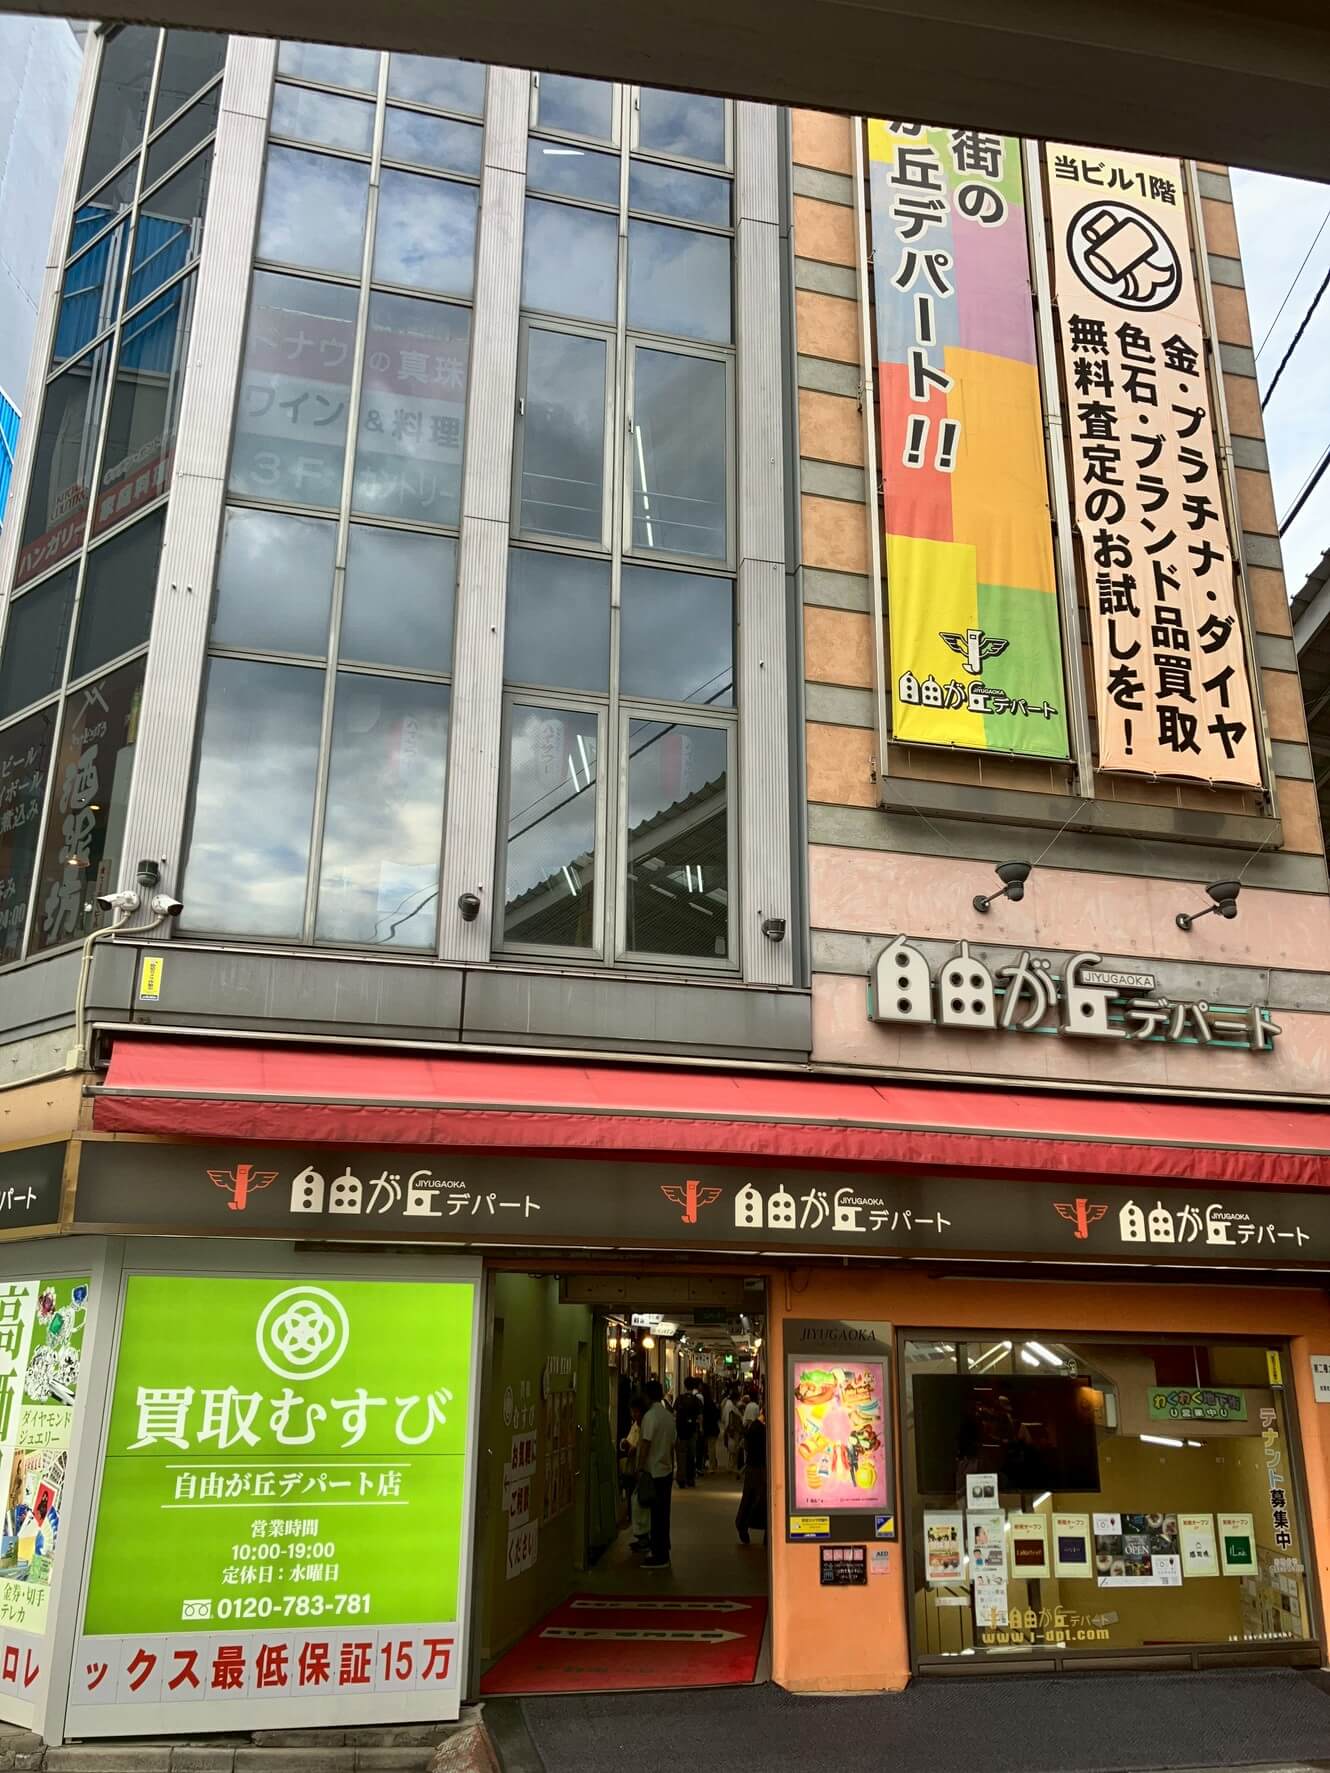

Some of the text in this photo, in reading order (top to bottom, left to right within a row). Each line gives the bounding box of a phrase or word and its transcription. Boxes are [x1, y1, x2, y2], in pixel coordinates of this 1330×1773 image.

[1053, 153, 1178, 206] 当ビル1階
[1115, 320, 1201, 755] 色石・ブランド品買取
[1161, 333, 1247, 760] 金・プラチナ・ダイヤ
[871, 933, 1283, 1052] 自由が丘デパート
[1081, 971, 1155, 990] JIYUGAOKA
[290, 1166, 541, 1217] 自由が丘デパート
[416, 1180, 466, 1190] JIYUGAOKA
[734, 1183, 952, 1234] 自由が丘デパート
[840, 1196, 885, 1208] JIYUGAOKA
[1118, 1200, 1310, 1248] 自由が丘デパート
[1211, 1212, 1250, 1222] JIYUGAOKA
[800, 1327, 877, 1342] JIYUGAOKA
[23, 1411, 72, 1430] ダイヤモンド
[126, 1385, 454, 1450] 買取むすび
[19, 1430, 61, 1446] ジュエリー
[173, 1470, 402, 1500] 自由が丘デパート店
[1260, 1407, 1292, 1550] テナント募集中
[250, 1519, 319, 1538] 営業時間
[231, 1543, 335, 1560] 10:00-19:00
[4, 1585, 45, 1608] 金券・切手
[216, 1594, 371, 1620] 0120-783-781
[0, 1603, 26, 1624] テレカ
[2, 1645, 40, 1689] ロレ
[86, 1637, 456, 1692] ックス最低保証15万
